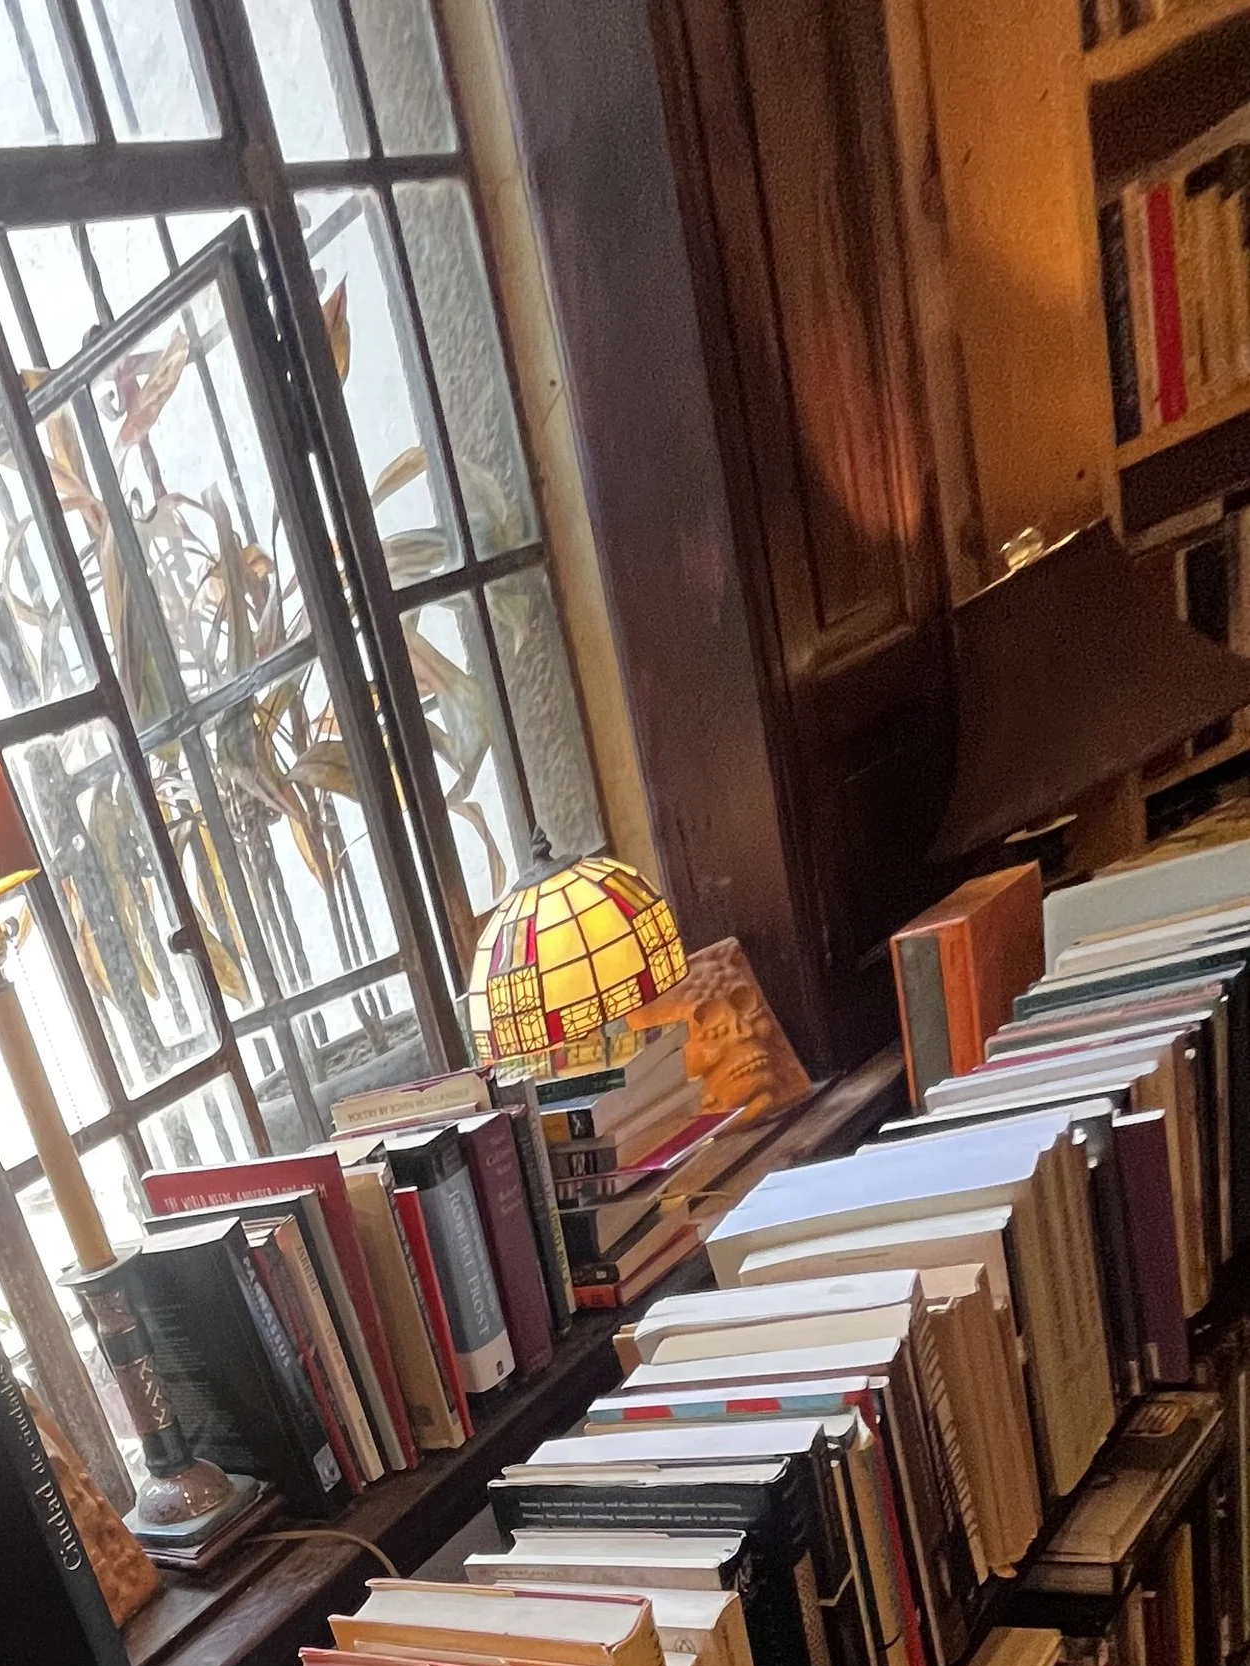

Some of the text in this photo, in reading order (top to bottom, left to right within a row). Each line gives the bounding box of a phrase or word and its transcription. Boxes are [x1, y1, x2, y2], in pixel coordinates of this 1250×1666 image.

[348, 1108, 377, 1122] POETRY
[390, 1101, 414, 1115] JOHN
[243, 1255, 292, 1369] PARNASSUS
[450, 1189, 491, 1338] ROBERT FROST
[0, 1364, 82, 1571] Ciudad de ciudades
